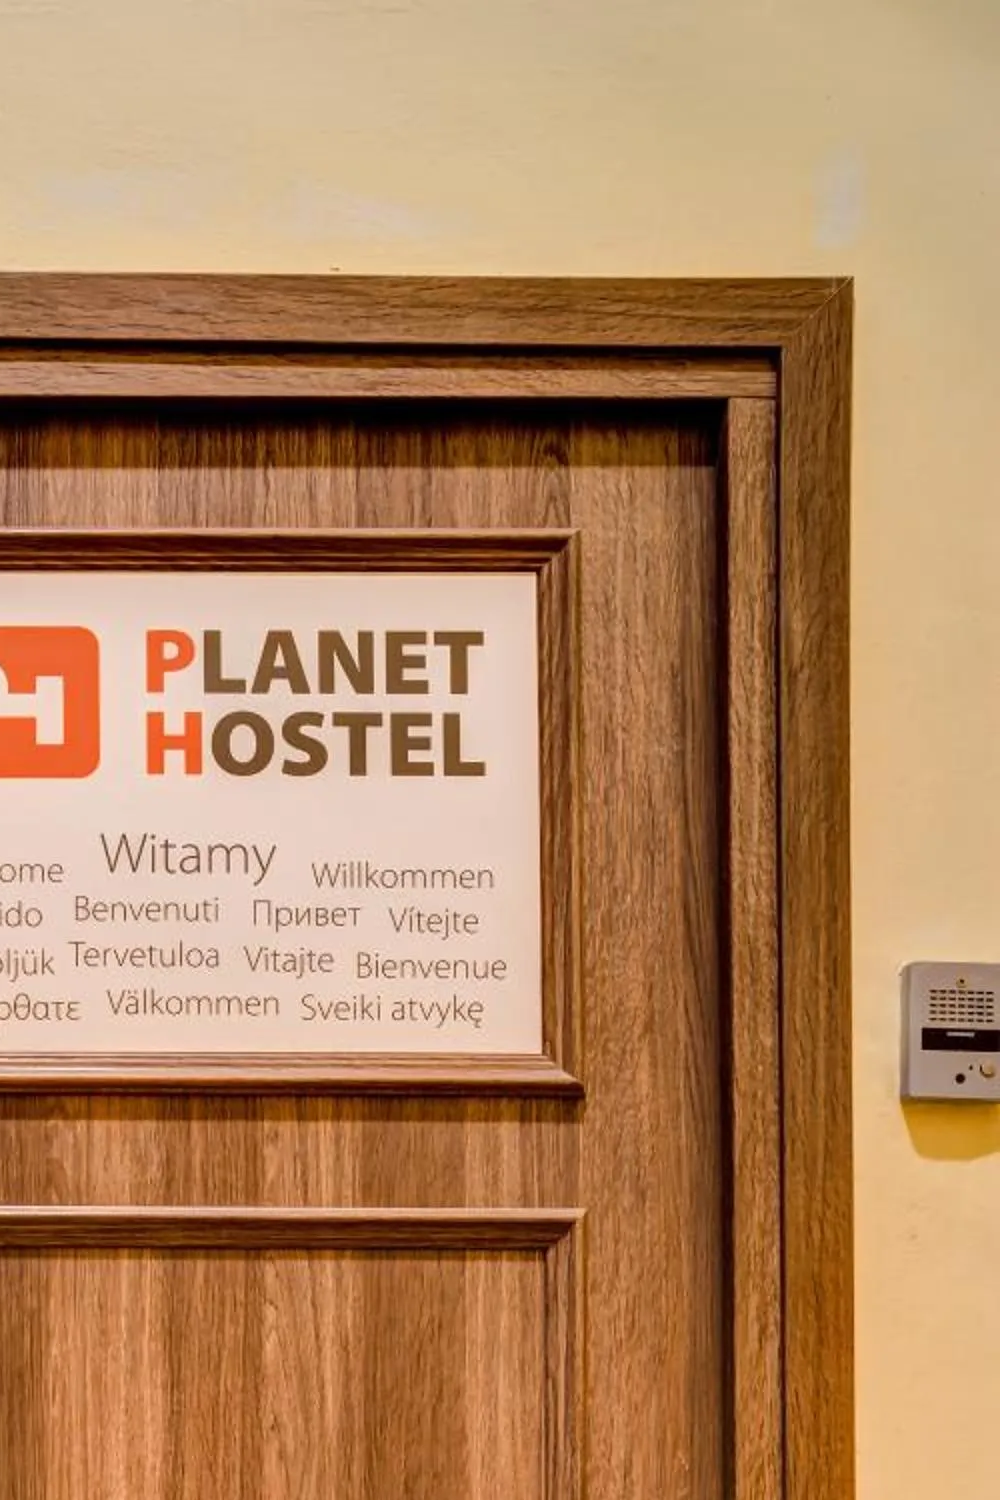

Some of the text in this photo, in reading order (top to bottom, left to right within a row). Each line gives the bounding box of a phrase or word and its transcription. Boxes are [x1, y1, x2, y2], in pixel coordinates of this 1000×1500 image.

[145, 629, 485, 695] PLANET
[146, 710, 487, 777] HOSTEL
[99, 832, 277, 887] Witamy
[311, 859, 495, 890] Willkommen
[74, 895, 219, 923] Benvenuti
[252, 899, 362, 934] Привет
[388, 905, 480, 941] Vítejte
[67, 939, 220, 969] Tervetuloa
[242, 945, 335, 980] Vitajte
[356, 951, 508, 981] Bienvenue
[105, 987, 280, 1017] Välkommen
[300, 993, 485, 1029] Sveiki atvykę
